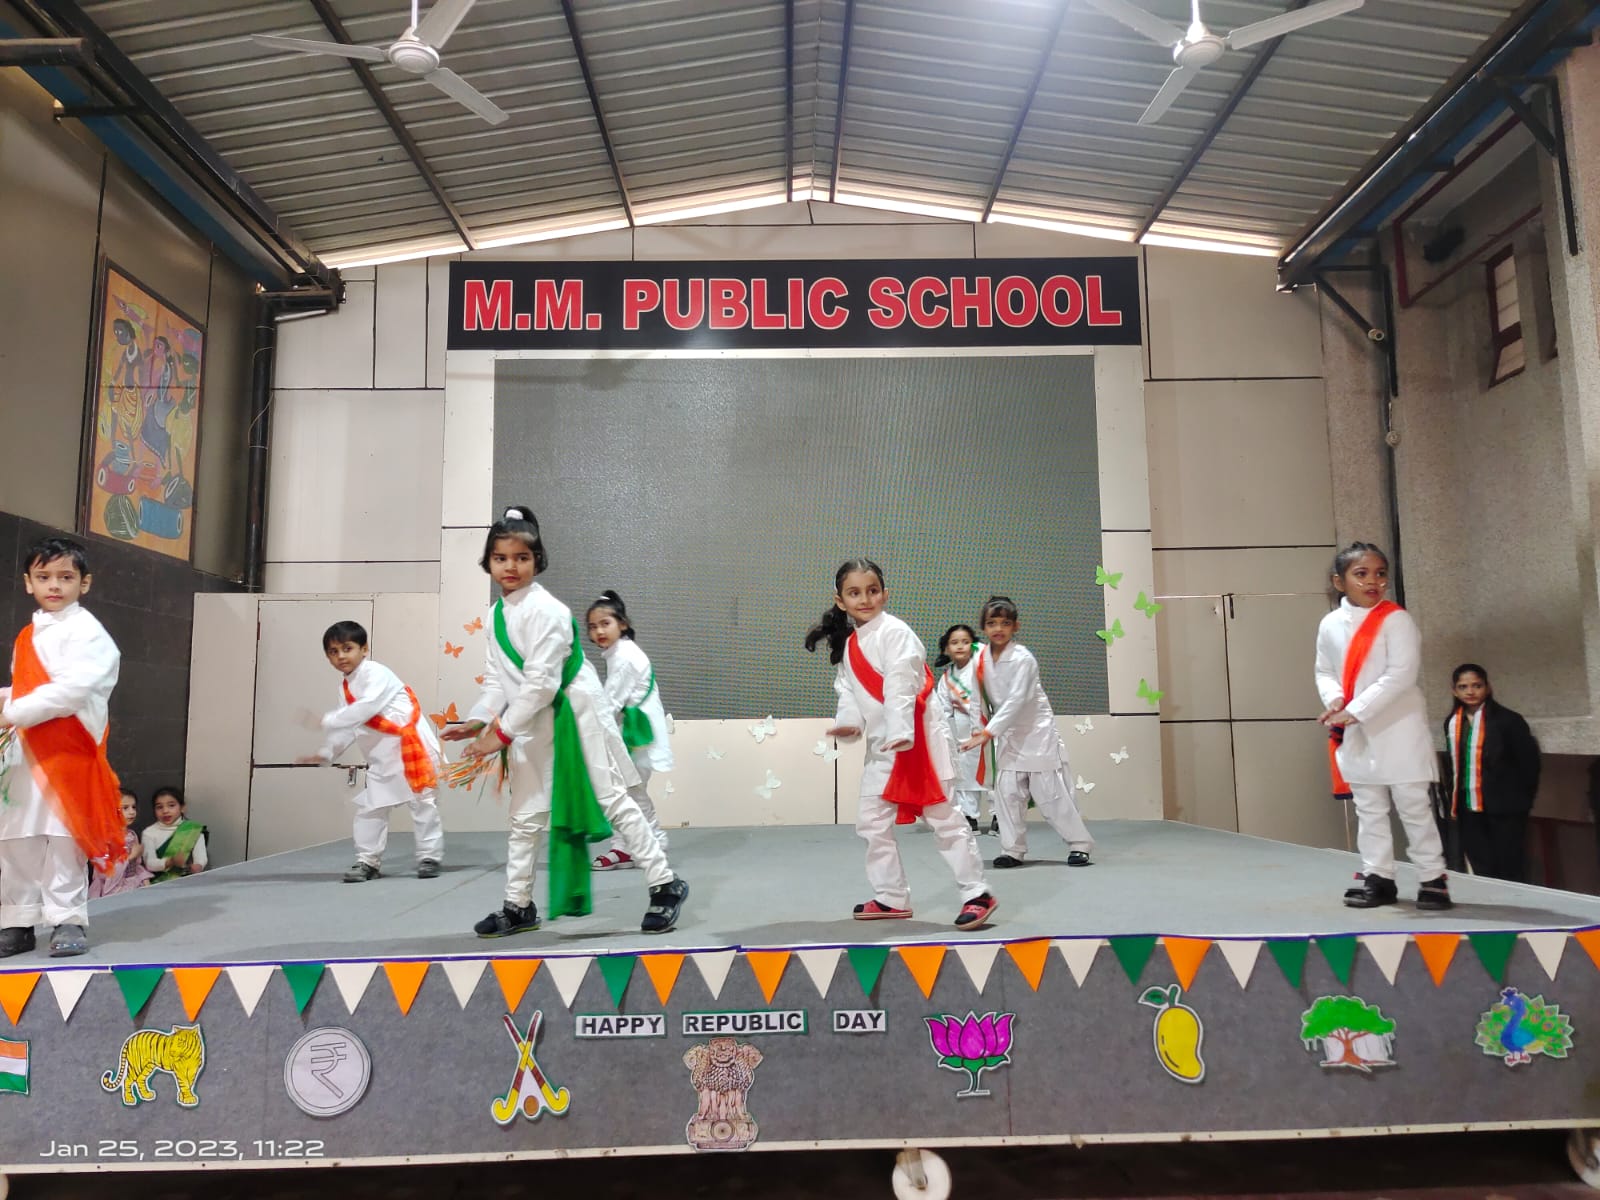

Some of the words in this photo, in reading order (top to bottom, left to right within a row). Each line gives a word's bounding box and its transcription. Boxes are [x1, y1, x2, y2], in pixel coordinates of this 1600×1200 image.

[463, 279, 602, 331] M.M.
[622, 277, 849, 330] PUBLIC
[868, 275, 1122, 329] SCHOOL
[582, 1017, 661, 1034] HAPPY
[685, 1013, 802, 1032] REPUBLIC
[836, 1013, 882, 1029] DAY
